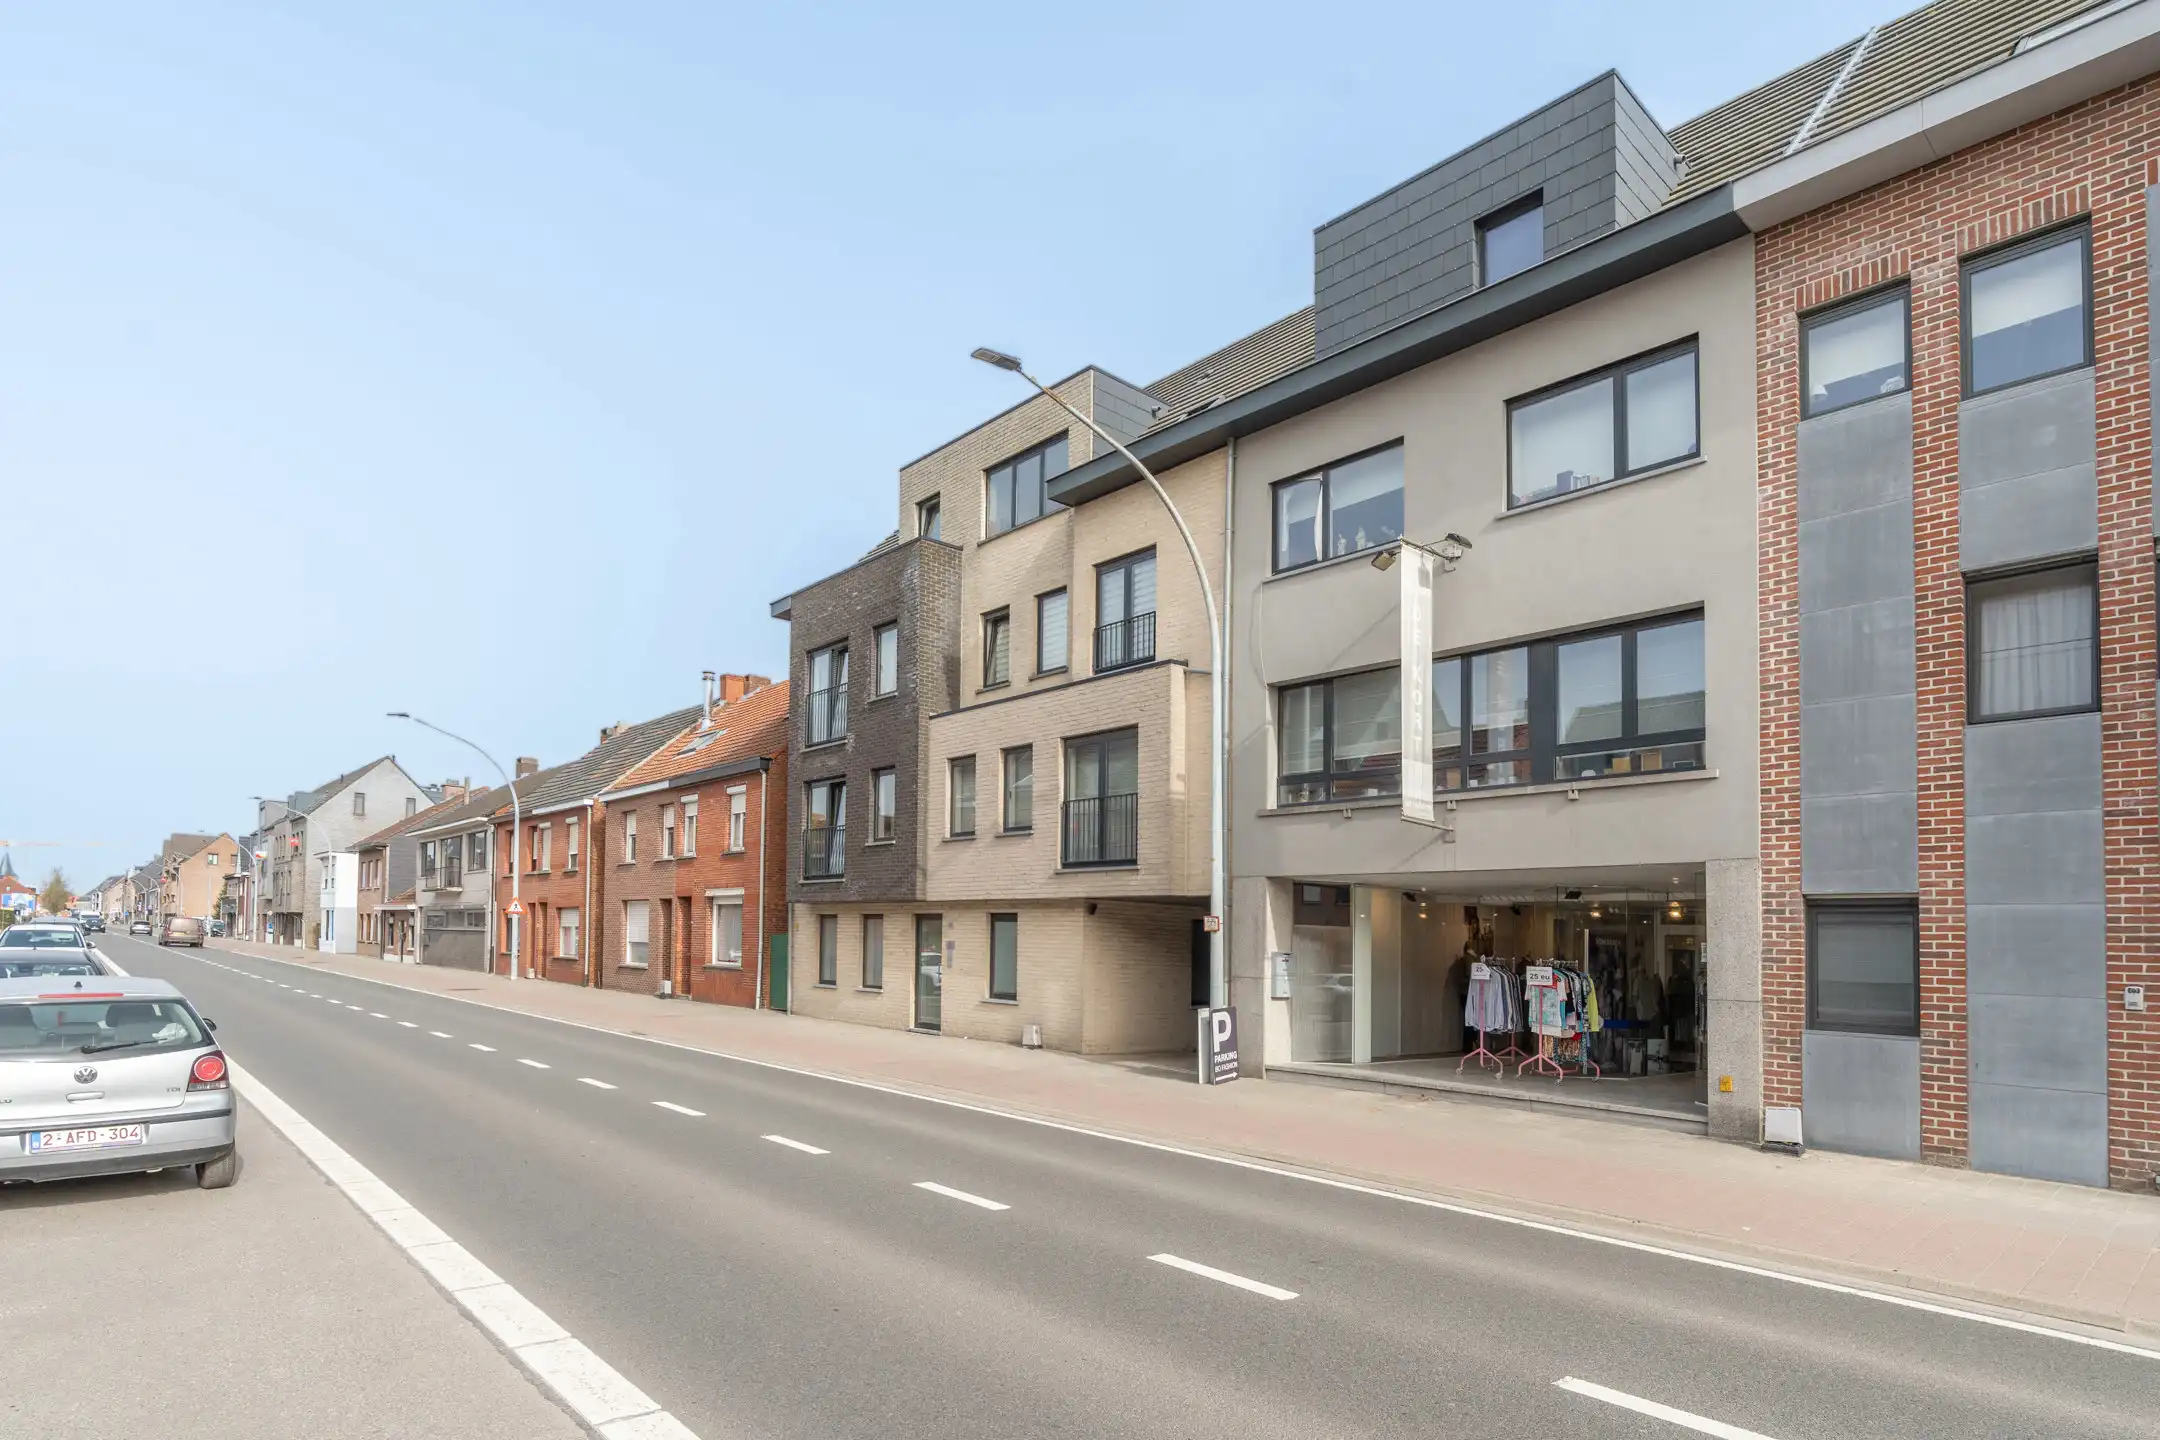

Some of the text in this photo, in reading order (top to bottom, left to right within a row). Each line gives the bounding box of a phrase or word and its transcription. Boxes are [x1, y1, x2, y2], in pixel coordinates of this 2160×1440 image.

[1212, 1011, 1232, 1053] P
[1214, 1050, 1238, 1064] PARKING
[1221, 1061, 1238, 1071] FASHION
